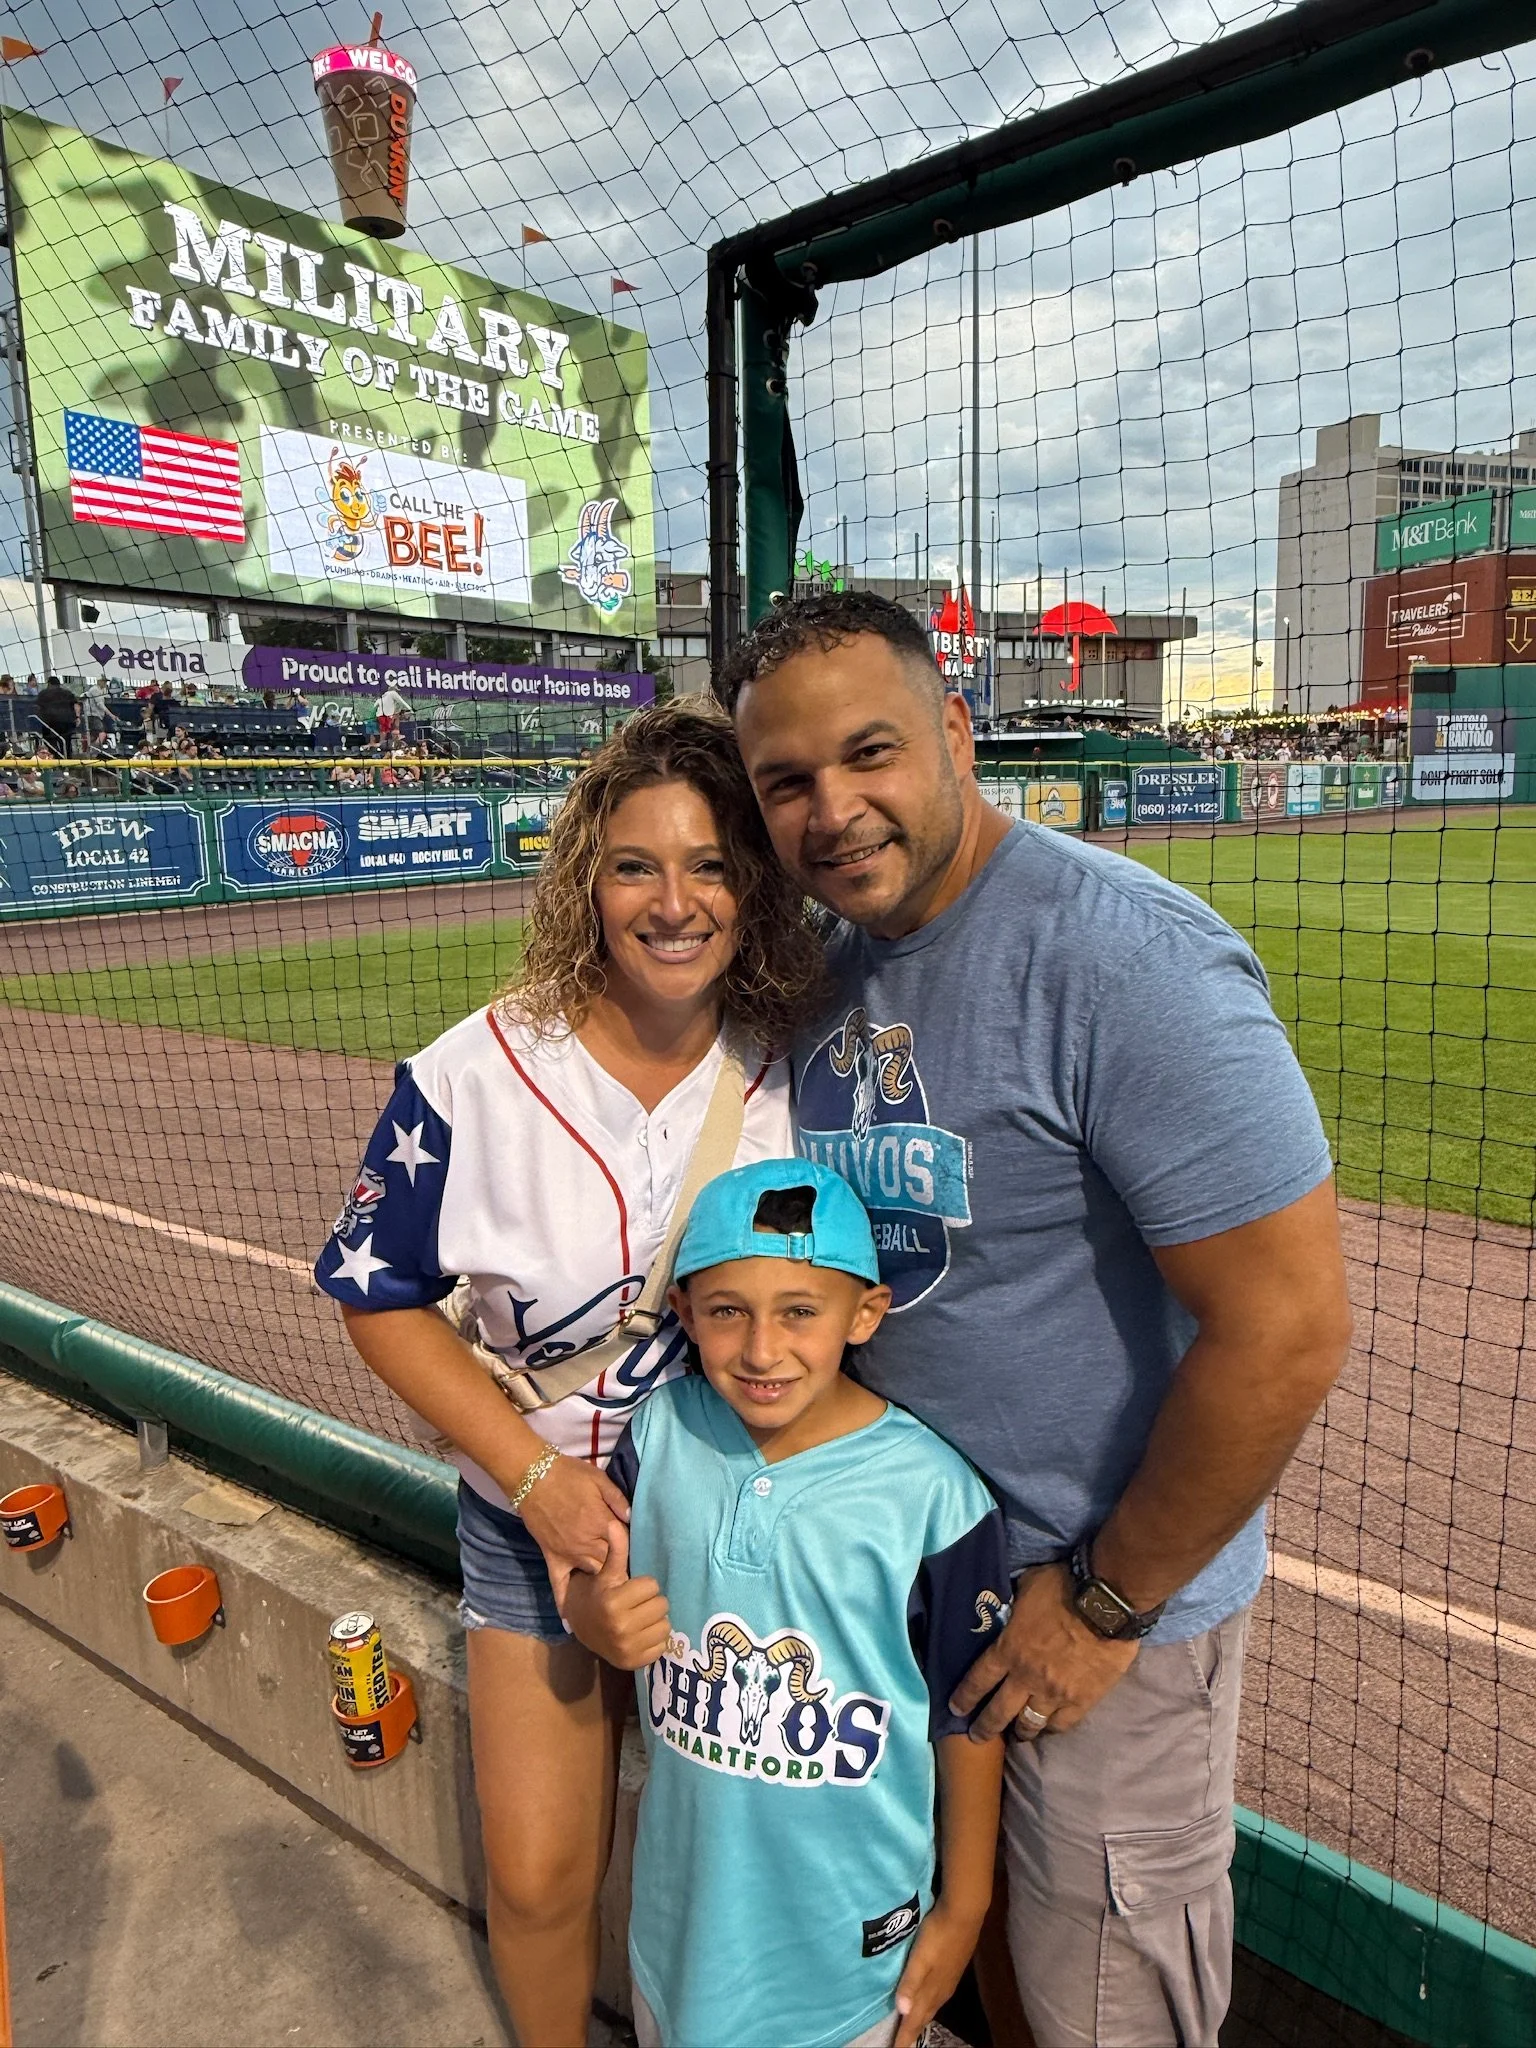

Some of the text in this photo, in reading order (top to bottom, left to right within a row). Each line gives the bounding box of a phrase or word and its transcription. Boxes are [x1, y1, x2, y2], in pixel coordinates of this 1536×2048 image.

[164, 200, 570, 391] MILITARY
[125, 284, 600, 444] FAMILY OF THE GAME
[329, 419, 432, 455] PRESENTED
[390, 493, 464, 520] CALL THE
[383, 512, 485, 576] BEE!
[1391, 511, 1478, 552] M&T Bank
[1391, 601, 1450, 624] TRAVELERS
[1411, 623, 1438, 638] Patio
[118, 645, 206, 674] aetna
[281, 657, 631, 699] Proud to call Hartford our home base
[1436, 714, 1488, 731] TRANTOLO
[1138, 773, 1219, 785] DRESSLER
[1159, 785, 1196, 797] LAW
[1137, 803, 1165, 816] (860)
[1168, 803, 1218, 814] 247-1122
[52, 816, 154, 849] IBEW
[358, 812, 472, 841] SMART
[258, 831, 339, 854] SMACNA
[65, 847, 149, 868] LOCAL 42
[360, 854, 388, 868] LOCAL
[412, 850, 441, 864] ROCKY
[463, 847, 473, 860] CT
[31, 874, 181, 896] CONSTRUCTION LINEMEN
[372, 1639, 384, 1674] TEA
[679, 1727, 824, 1780] HARTFORD
